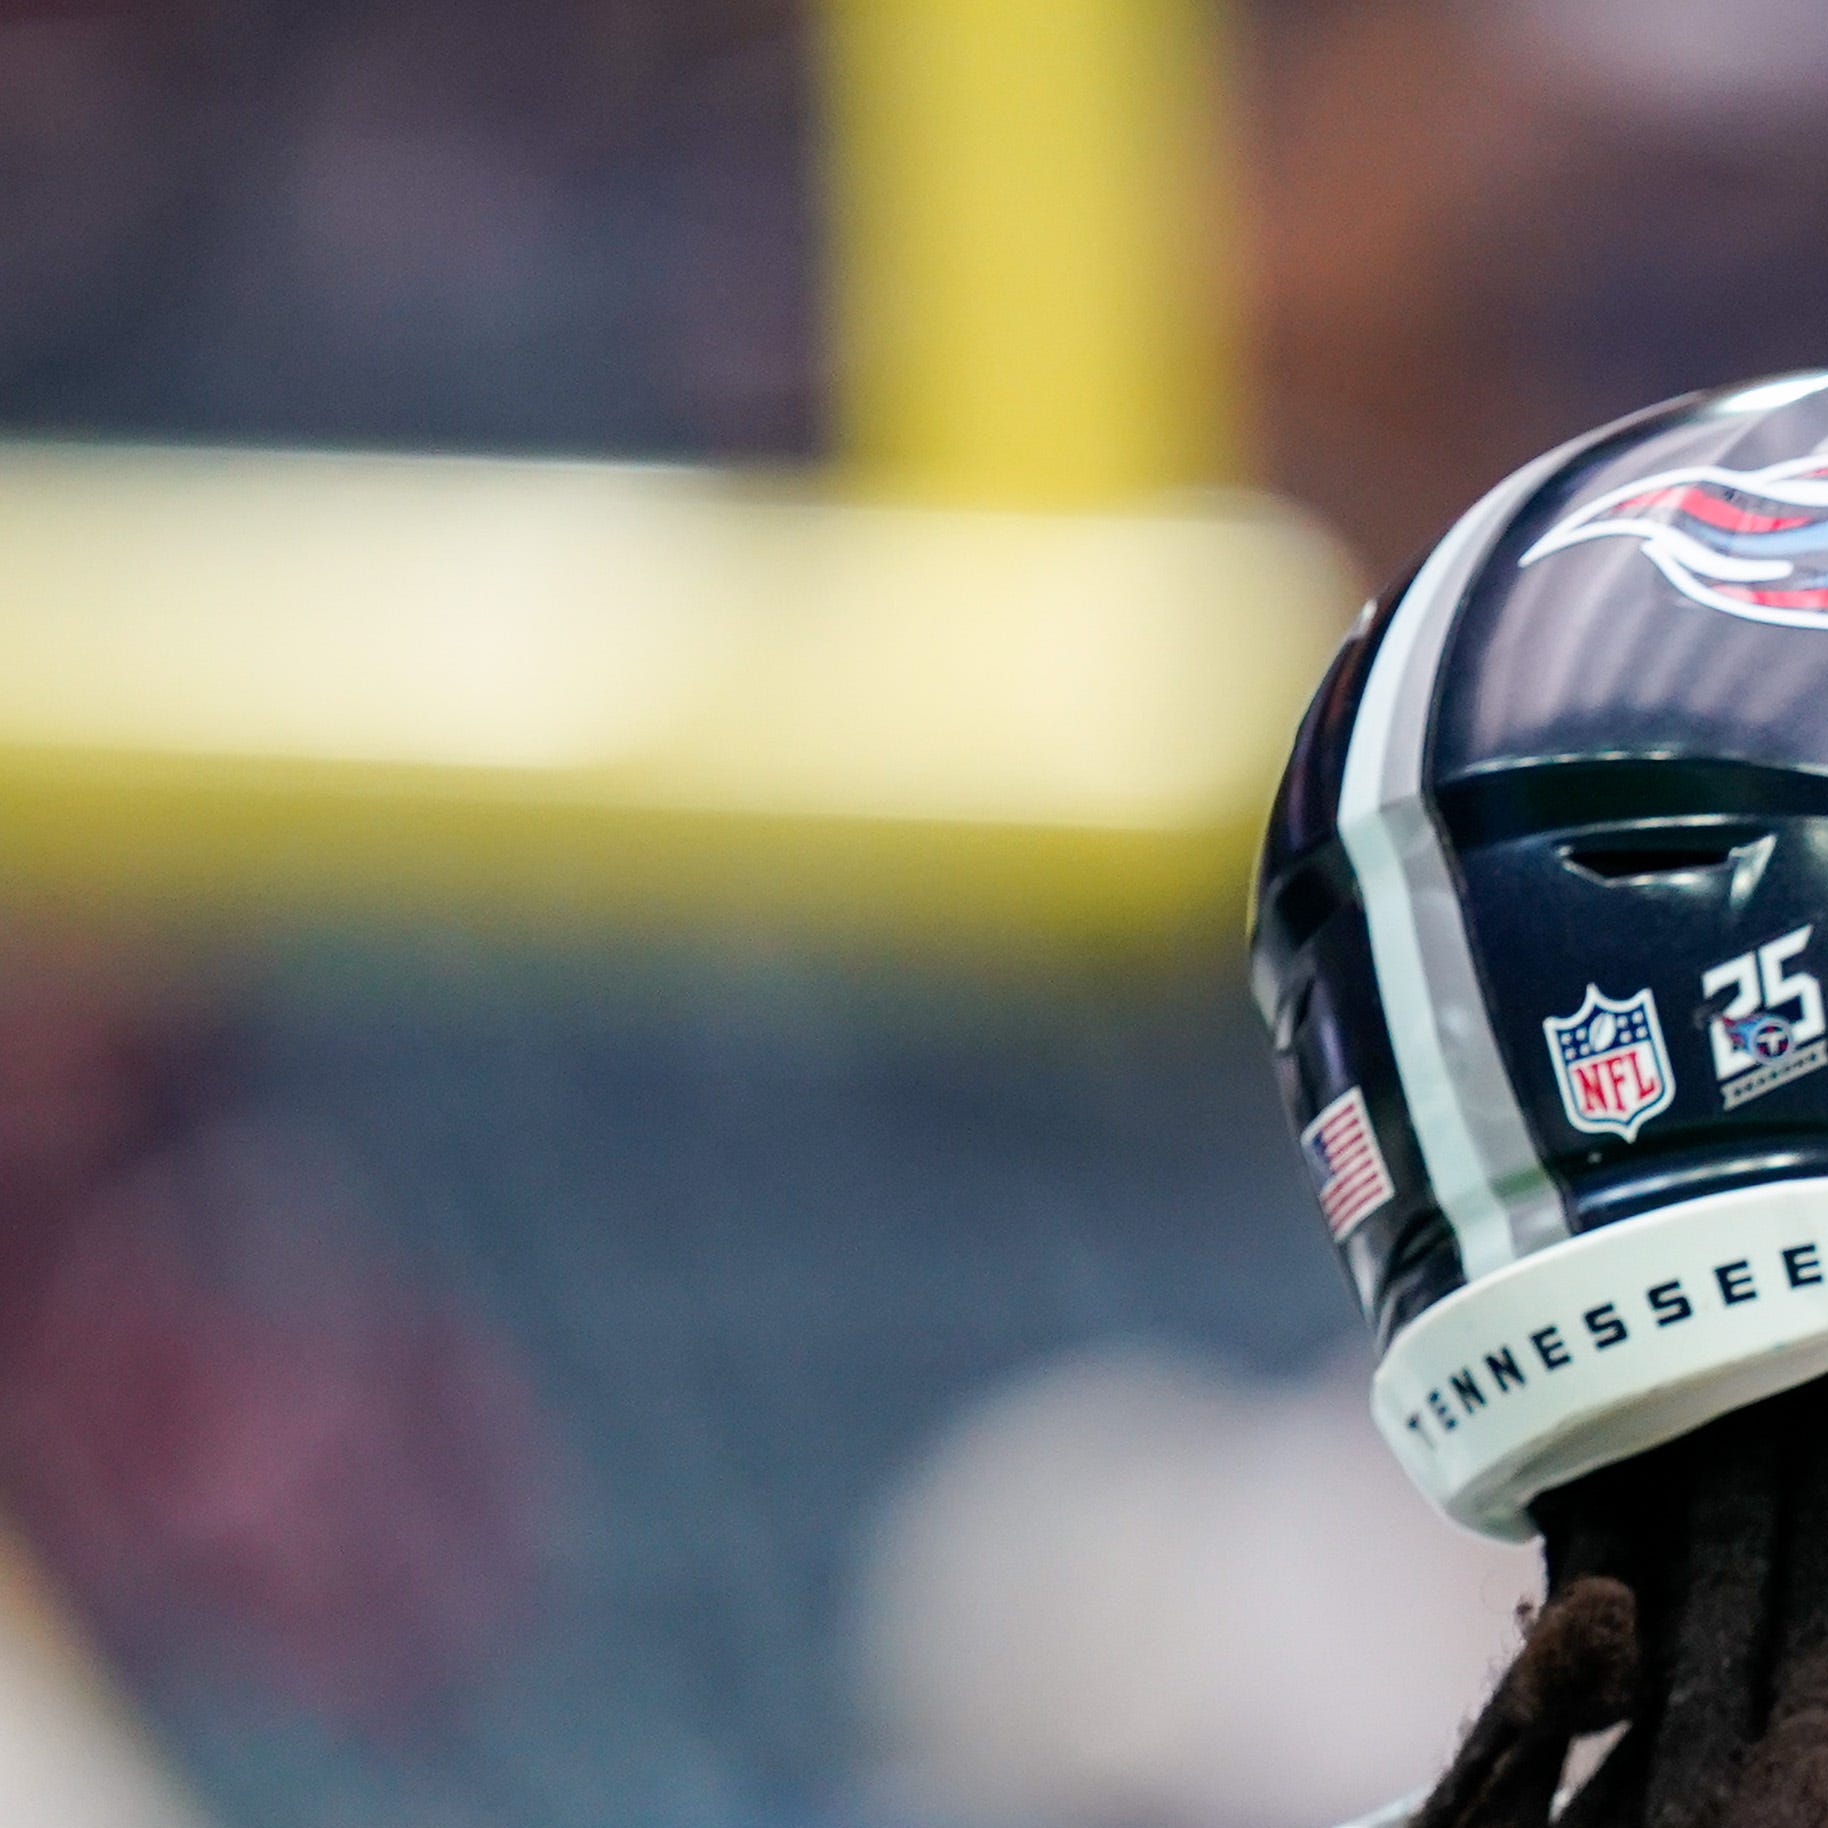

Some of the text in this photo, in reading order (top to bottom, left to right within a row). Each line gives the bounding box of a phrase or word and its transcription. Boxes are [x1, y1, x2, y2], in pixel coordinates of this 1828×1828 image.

[1702, 924, 1826, 1081] 25
[1575, 1051, 1656, 1112] NFL
[1407, 1243, 1824, 1449] TENNESSEE
